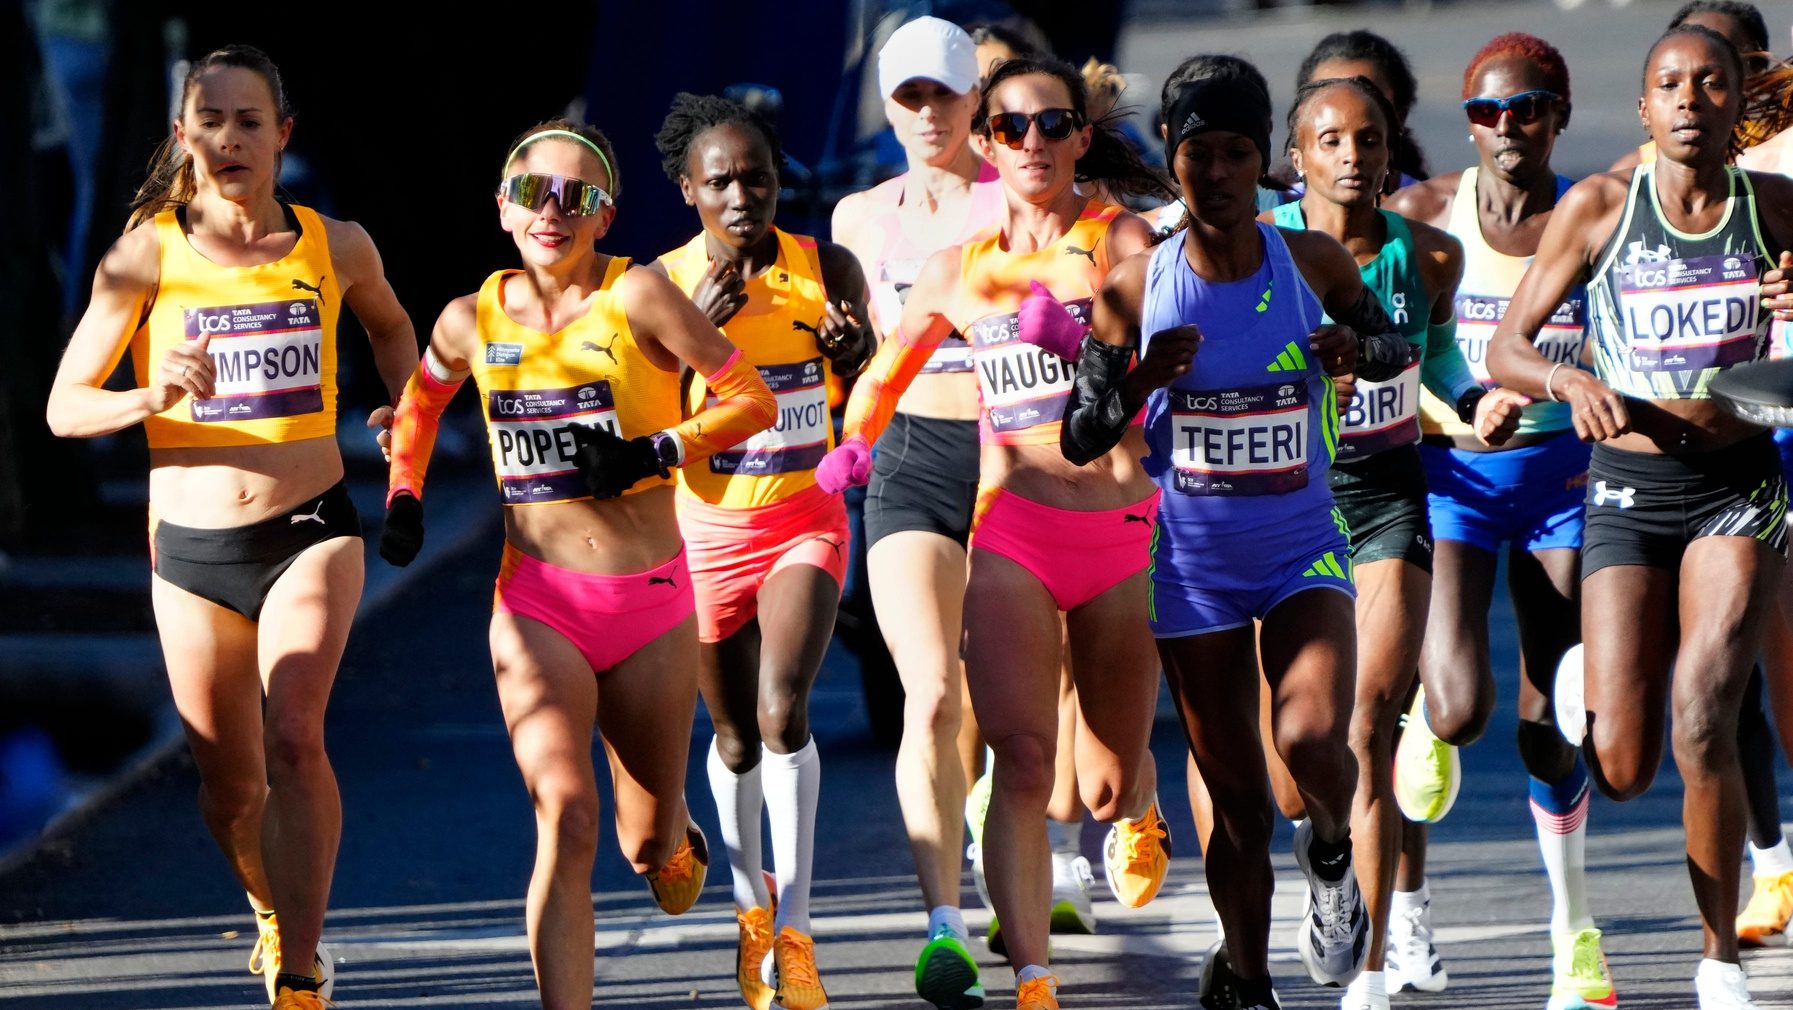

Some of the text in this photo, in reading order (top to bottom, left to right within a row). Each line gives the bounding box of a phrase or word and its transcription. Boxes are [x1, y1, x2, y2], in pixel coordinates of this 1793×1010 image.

[1634, 267, 1666, 288] tcs
[1722, 270, 1746, 279] TATA
[232, 308, 252, 316] TATA
[1463, 298, 1496, 320] tcs
[232, 314, 276, 323] CONSULTANCY
[288, 316, 310, 325] TATA
[1630, 294, 1755, 340] LOKEDI
[198, 312, 230, 332] tcs
[234, 322, 262, 330] SERVICES
[982, 324, 1010, 343] tcs
[802, 375, 819, 384] TATA
[498, 395, 524, 414] tcs
[577, 400, 602, 409] TATA
[1186, 394, 1218, 410] tcs
[1220, 396, 1264, 404] CONSULTANCY
[1276, 397, 1298, 406] TATA
[1221, 404, 1248, 412] SERVICES
[1181, 422, 1302, 465] TEFERI
